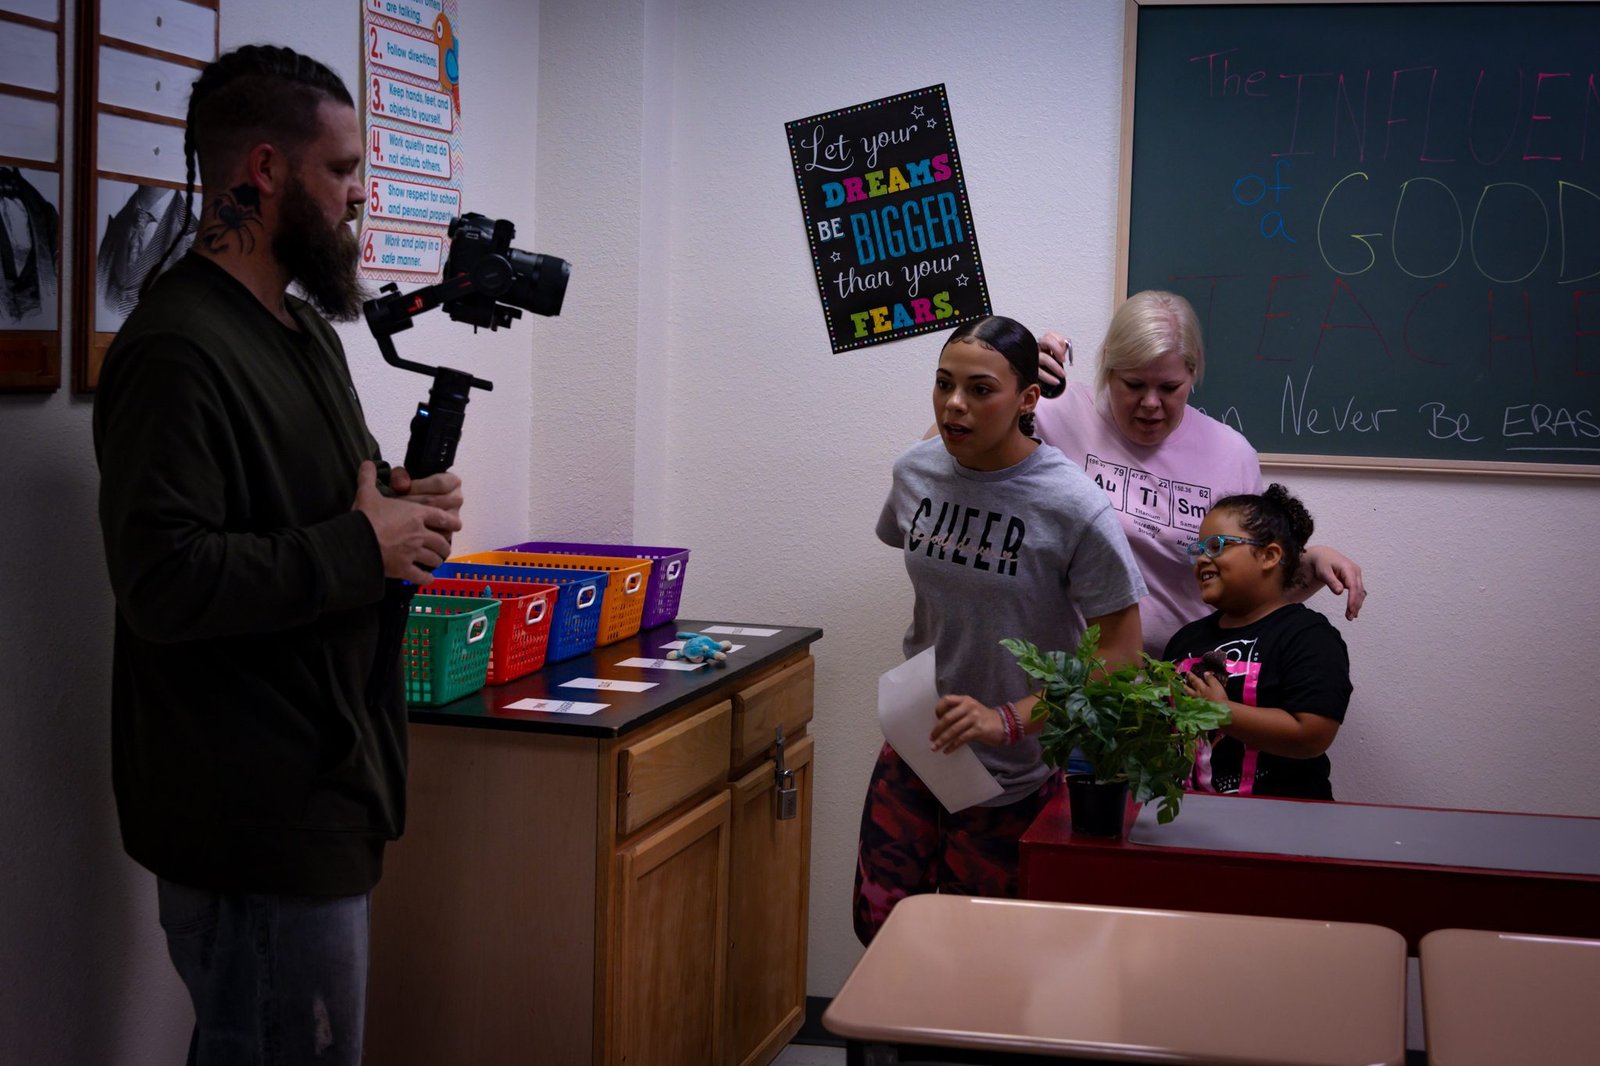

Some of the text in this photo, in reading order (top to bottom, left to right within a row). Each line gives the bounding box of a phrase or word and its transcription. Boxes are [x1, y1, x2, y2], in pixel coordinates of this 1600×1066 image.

[386, 2, 397, 13] are
[371, 27, 437, 67] 2. Follow directions.
[1188, 48, 1270, 97] The
[373, 78, 384, 112] 3.
[389, 83, 404, 98] Keep
[438, 98, 448, 110] and
[389, 103, 409, 116] objects
[411, 108, 417, 117] to
[373, 130, 447, 161] 4. Work quietly and do
[801, 124, 918, 172] Let your
[388, 154, 398, 164] not
[400, 155, 420, 168] disturb
[821, 152, 953, 209] DREAMS
[1232, 159, 1295, 206] of
[371, 182, 458, 212] 5. Show respect for school
[388, 203, 400, 214] and
[402, 206, 428, 219] personal
[817, 191, 965, 266] BE BIGGER
[1260, 209, 1297, 244] a
[1318, 172, 1600, 284] GOOD
[364, 233, 375, 263] 6.
[385, 235, 400, 247] Work
[402, 236, 413, 248] and
[415, 237, 427, 251] play
[429, 238, 434, 248] in
[382, 253, 395, 265] safe
[833, 254, 960, 299] than your
[850, 290, 960, 339] FEARS.
[1168, 275, 1600, 383] TEACHE
[1281, 365, 1398, 437] Never
[1418, 401, 1485, 442] Be
[1503, 403, 1600, 438] ERAS
[1094, 473, 1117, 492] Au
[1113, 467, 1124, 477] 79
[1158, 480, 1168, 488] 22
[1140, 486, 1157, 507] Ti
[1178, 498, 1206, 518] Sm
[1199, 489, 1209, 498] 62
[1133, 519, 1161, 533] Incredibly
[1135, 508, 1161, 520] Titanium
[909, 497, 1026, 576] CHEER
